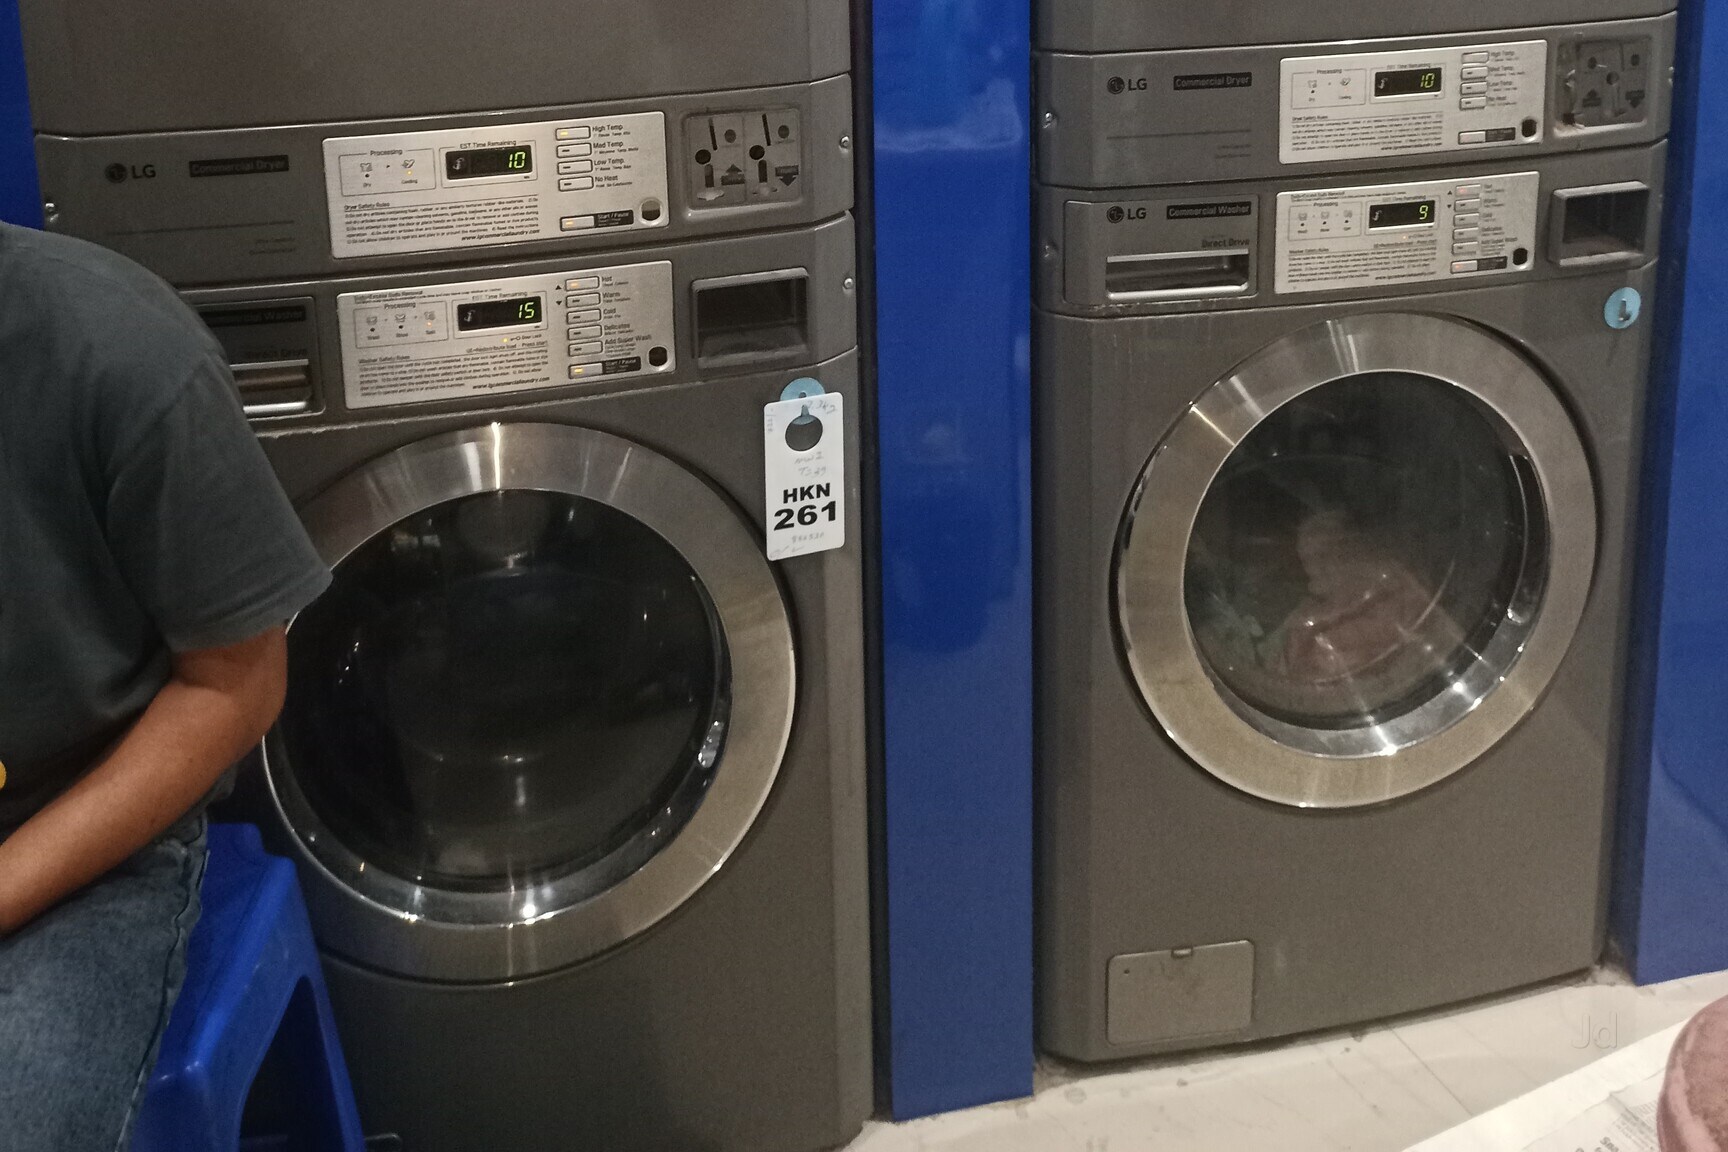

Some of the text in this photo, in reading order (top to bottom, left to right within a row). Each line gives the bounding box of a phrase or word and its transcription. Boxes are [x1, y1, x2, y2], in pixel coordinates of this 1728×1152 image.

[1128, 78, 1147, 91] LG
[1175, 76, 1250, 88] Commercial Dryer
[1420, 72, 1435, 88] 10
[508, 151, 526, 169] 10
[132, 165, 156, 179] LG
[1128, 207, 1147, 220] LG
[1169, 204, 1250, 218] Commercial Washer
[1419, 205, 1428, 220] 9
[518, 302, 535, 319] 15
[783, 483, 830, 504] HKN
[774, 500, 836, 532] 261
